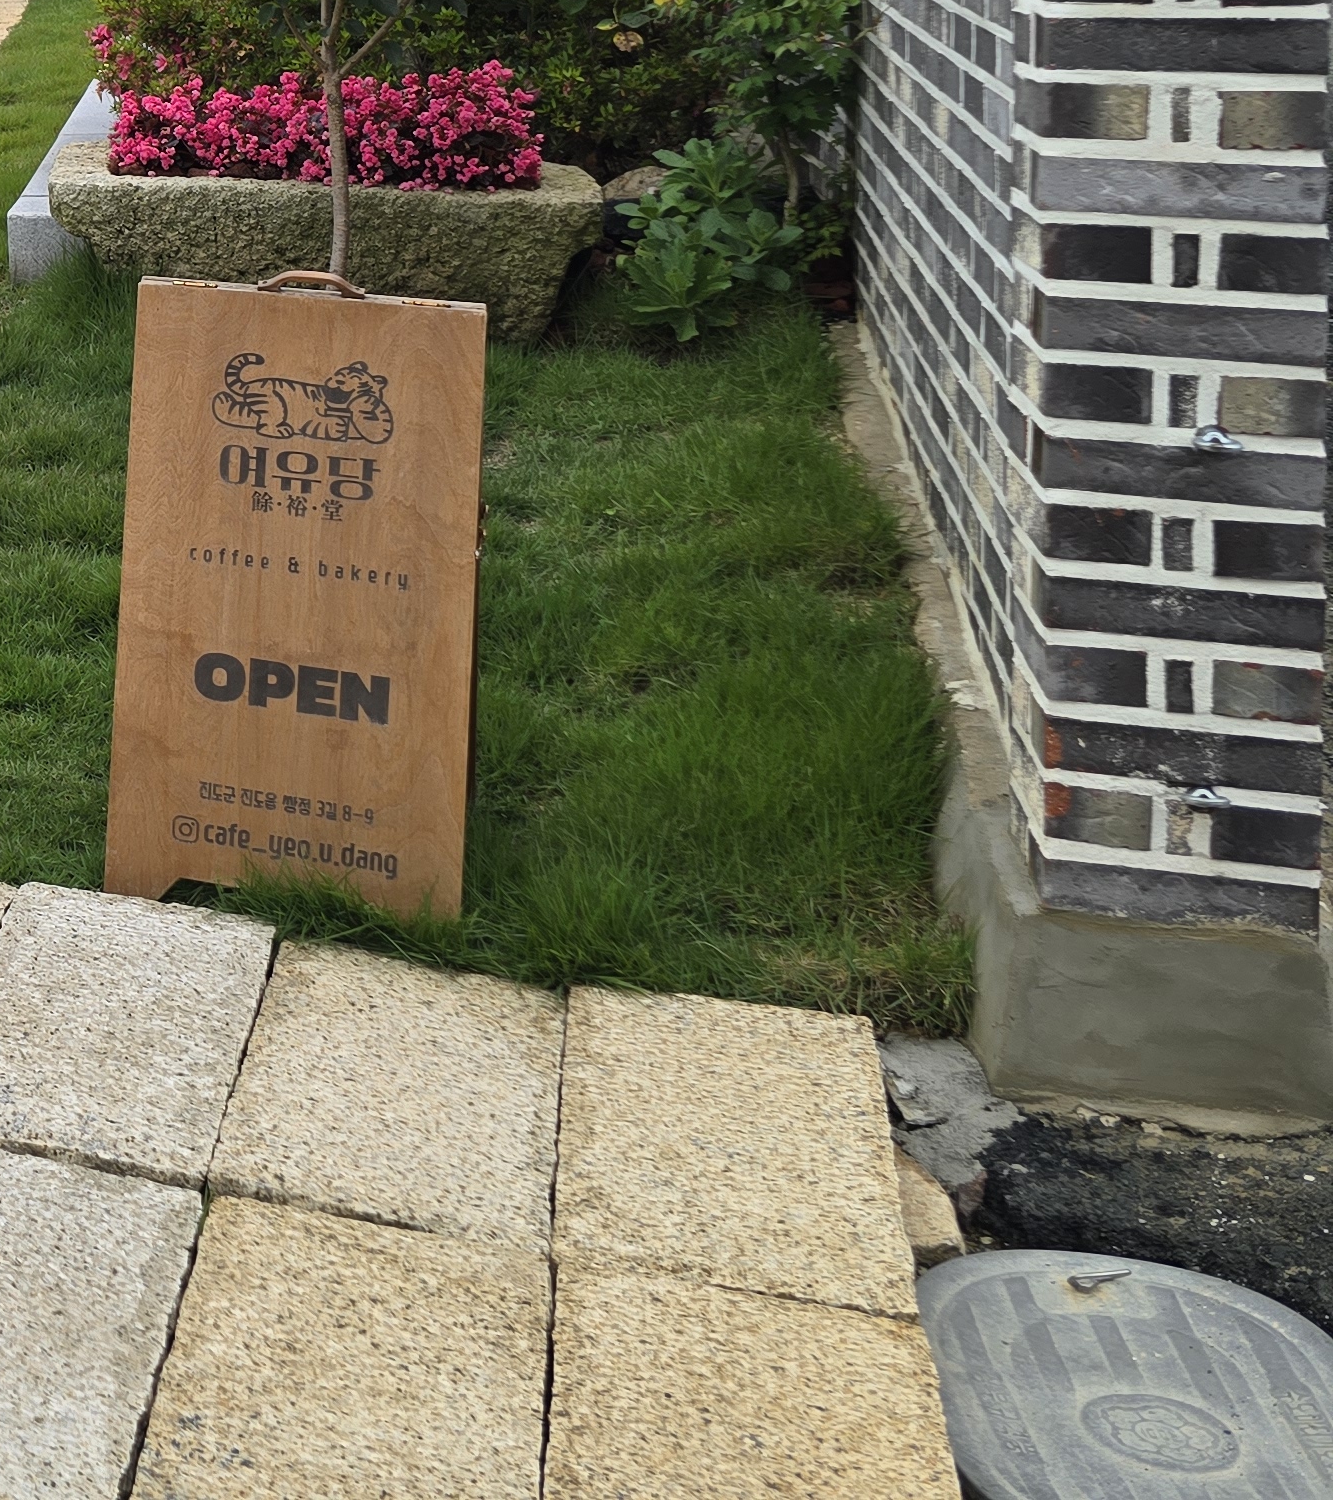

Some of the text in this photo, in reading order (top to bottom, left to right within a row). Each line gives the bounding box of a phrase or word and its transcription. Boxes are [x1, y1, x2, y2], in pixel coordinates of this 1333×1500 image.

[219, 444, 381, 501] 여유당
[189, 547, 410, 592] coffee & bakery
[194, 652, 391, 726] OPEN
[199, 781, 236, 805] 진도군
[241, 787, 278, 811] 진도읍
[316, 799, 337, 821] 3길
[342, 804, 375, 825] 8-9
[203, 823, 399, 881] cafe_yeo.u.dang
